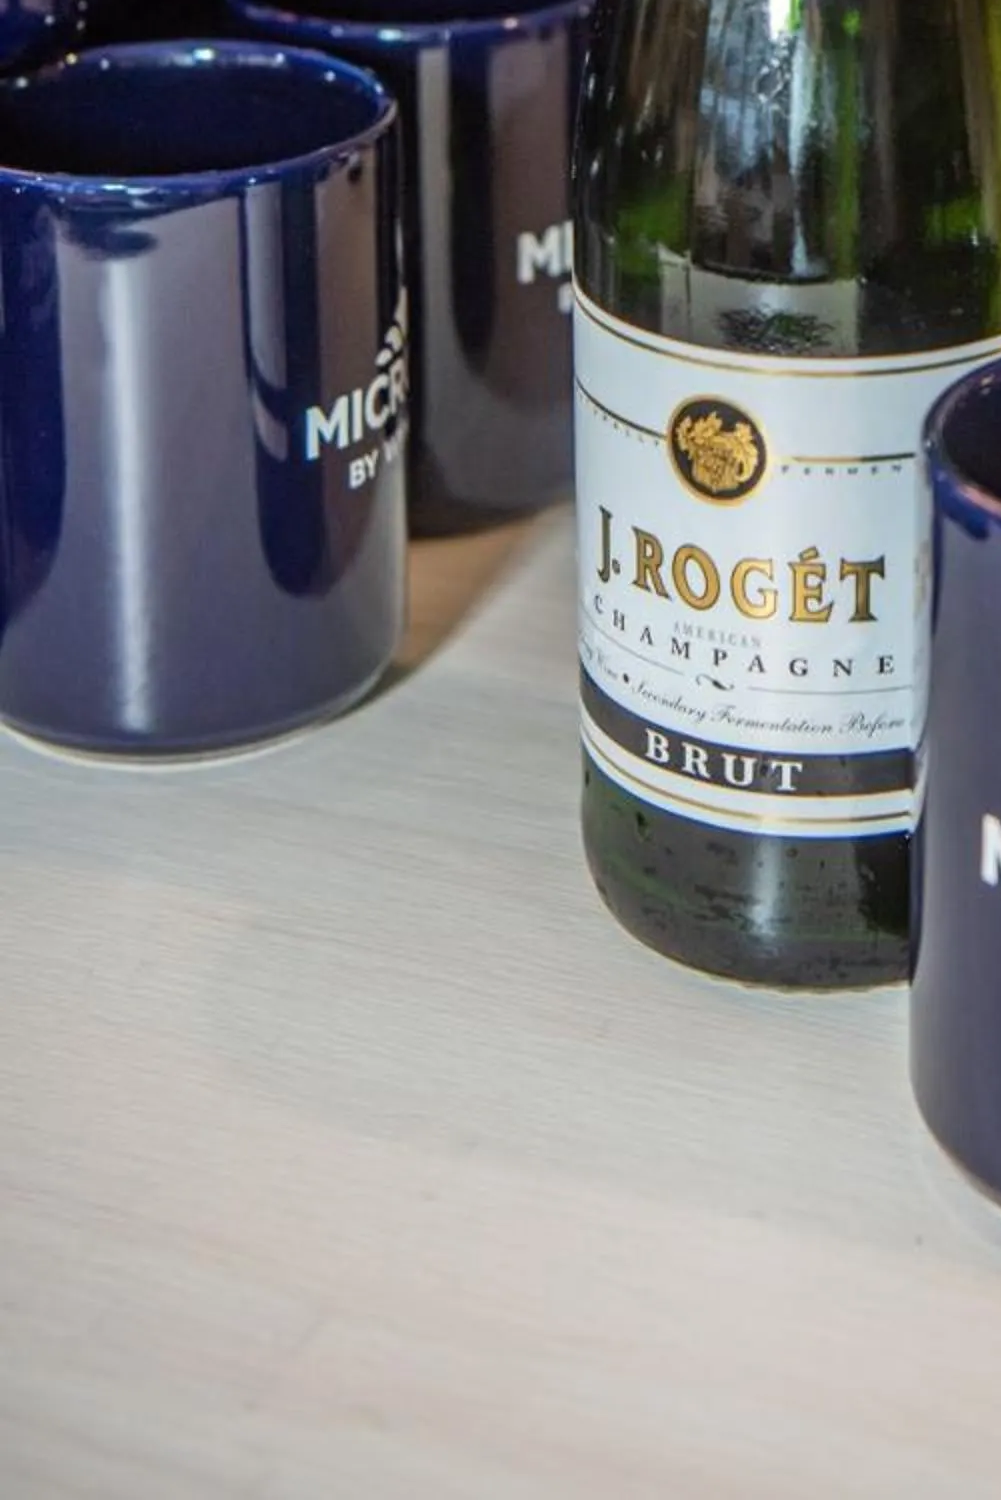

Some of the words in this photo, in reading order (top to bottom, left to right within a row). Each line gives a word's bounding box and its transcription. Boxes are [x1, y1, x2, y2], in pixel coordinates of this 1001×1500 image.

[349, 449, 378, 490] BY
[594, 594, 896, 677] CHAMPAGNE
[674, 620, 762, 648] AMERICAN
[631, 680, 707, 723] Secondary
[710, 702, 833, 735] Fermentation
[644, 727, 803, 792] BRUT
